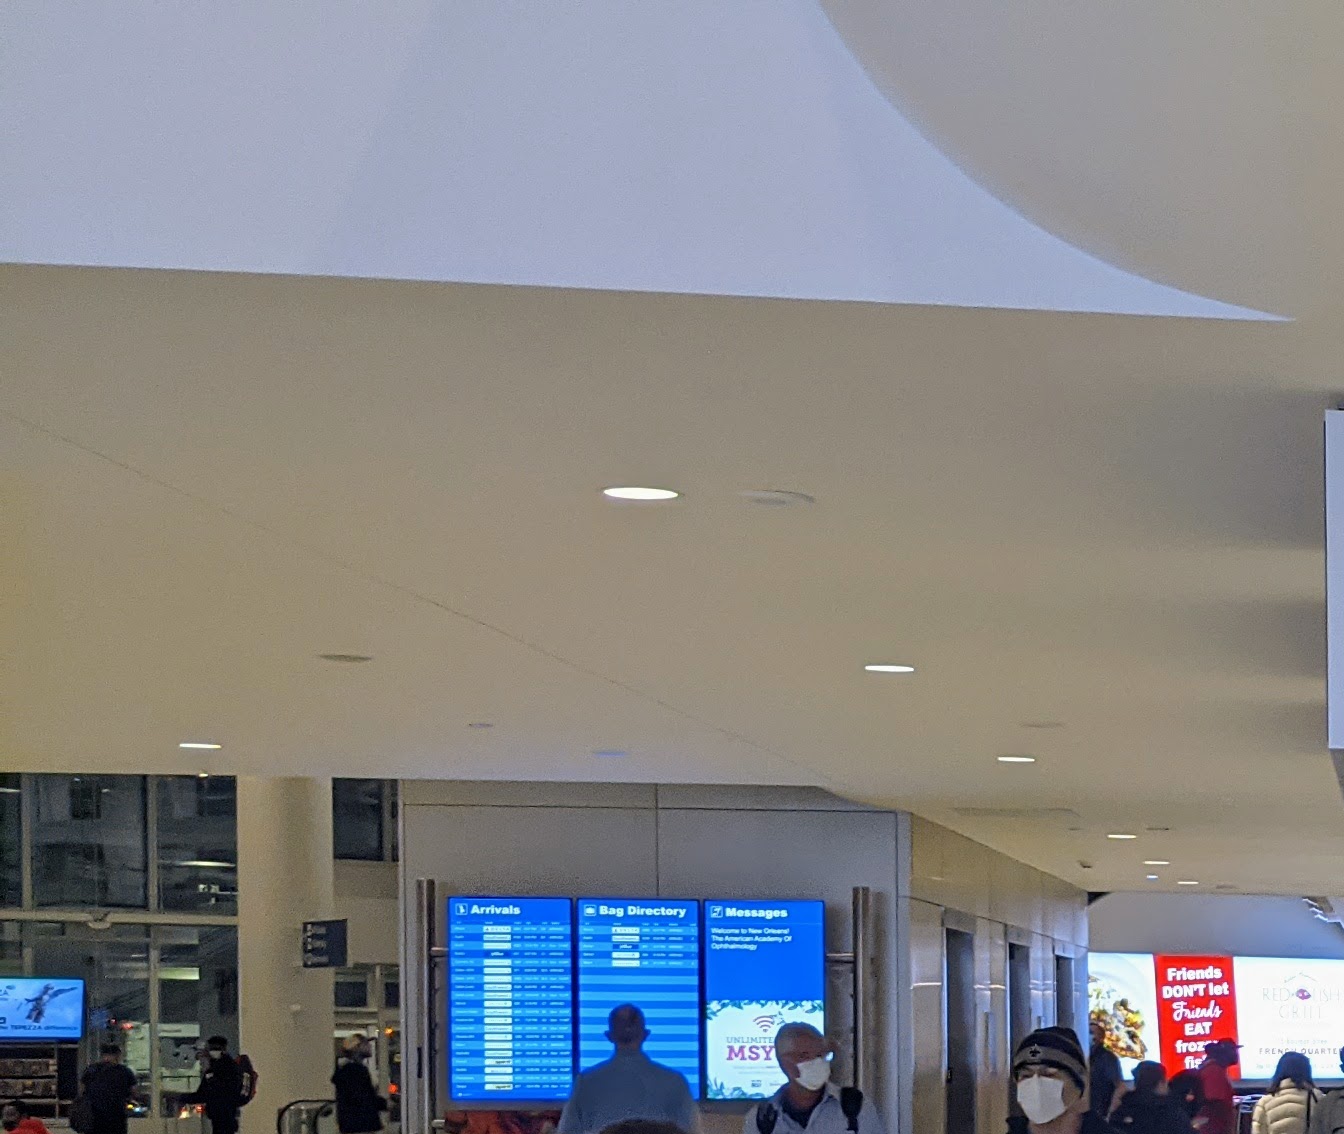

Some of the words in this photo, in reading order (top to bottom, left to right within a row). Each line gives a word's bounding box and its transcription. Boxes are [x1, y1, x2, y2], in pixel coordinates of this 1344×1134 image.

[470, 905, 521, 915] Arrivals
[599, 905, 625, 917] Bag
[627, 905, 687, 918] Directory
[725, 907, 788, 920] Messages
[754, 935, 782, 943] Academy
[711, 943, 757, 951] Ophthalmology
[1167, 966, 1222, 981] Friends
[1162, 983, 1206, 999] DON'T
[1208, 982, 1230, 996] let
[1262, 987, 1290, 1001] RED
[1172, 1000, 1222, 1021] Friends
[1184, 1022, 1212, 1036] EAT
[726, 1045, 776, 1060] MSY
[1175, 1040, 1219, 1053] froz
[1184, 1054, 1208, 1069] fis
